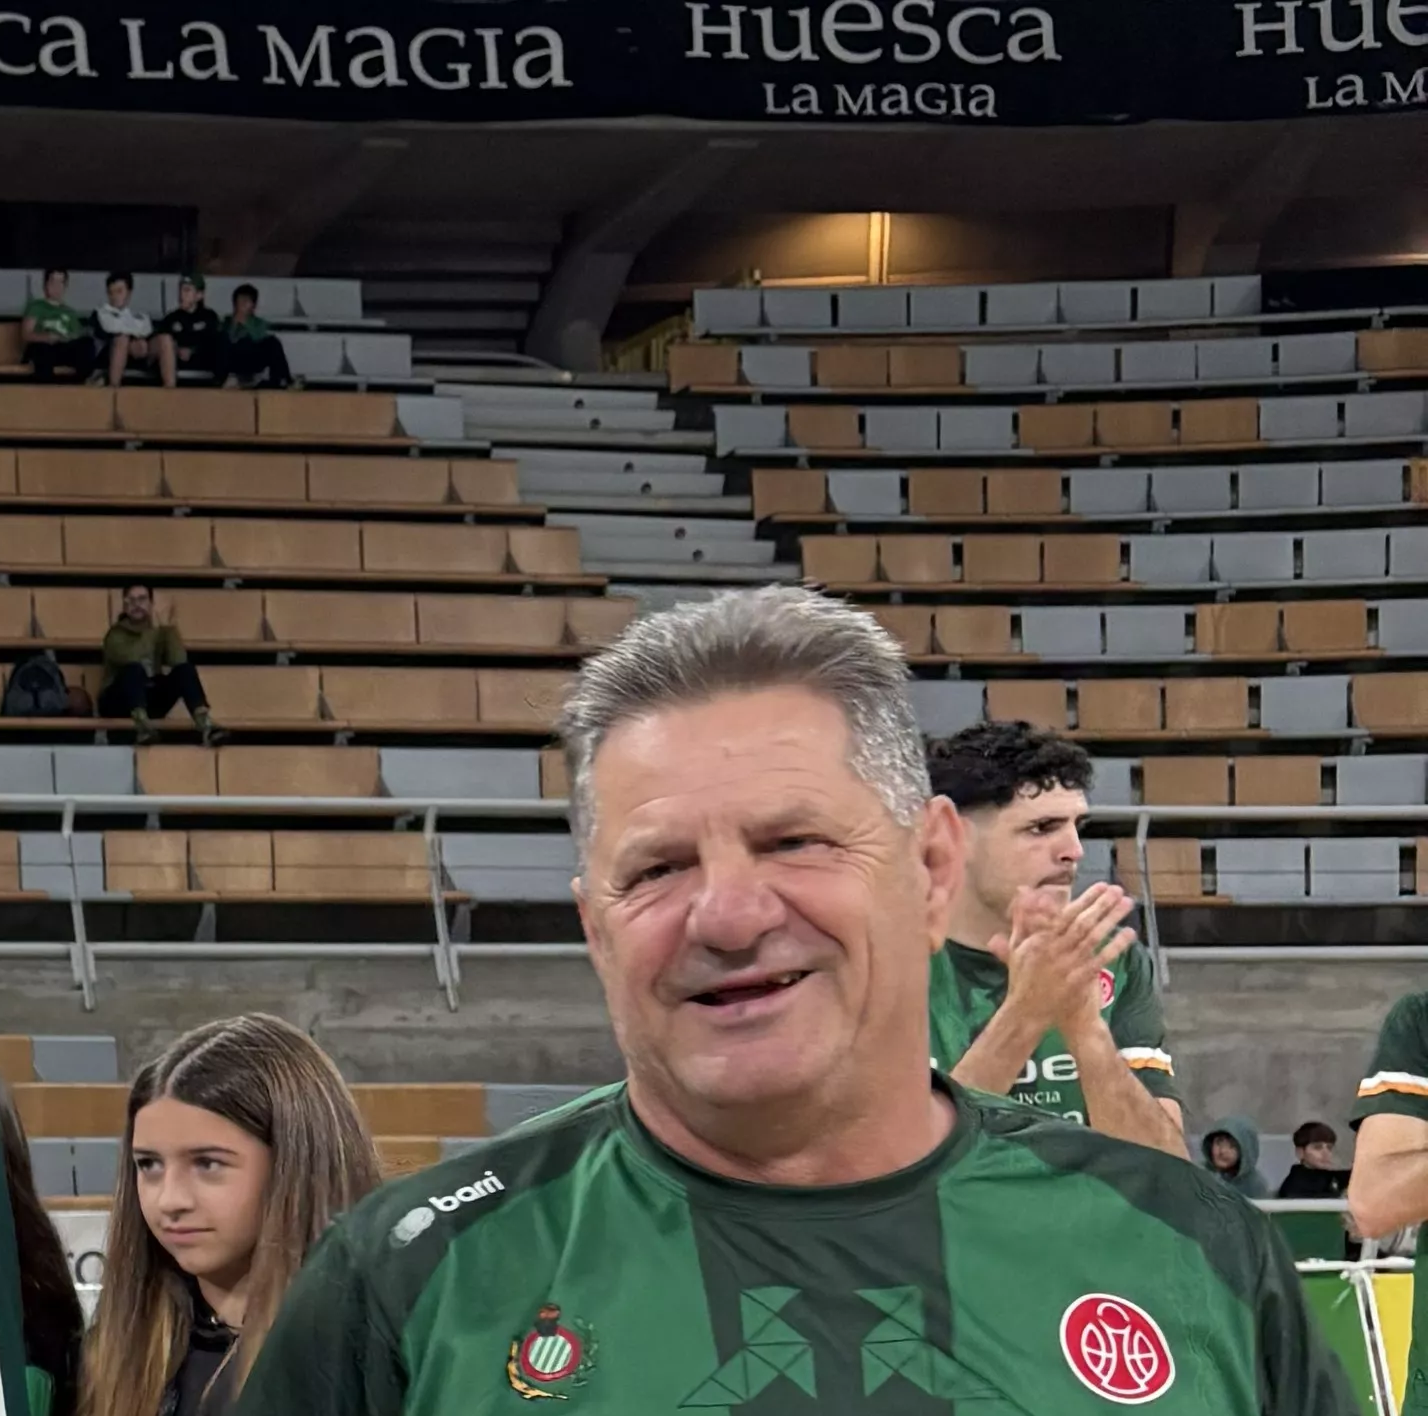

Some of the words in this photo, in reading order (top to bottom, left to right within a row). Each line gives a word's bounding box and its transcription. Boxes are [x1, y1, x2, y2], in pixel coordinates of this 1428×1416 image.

[120, 16, 240, 82] La
[684, 0, 1063, 65] Huesca
[762, 82, 824, 115] La
